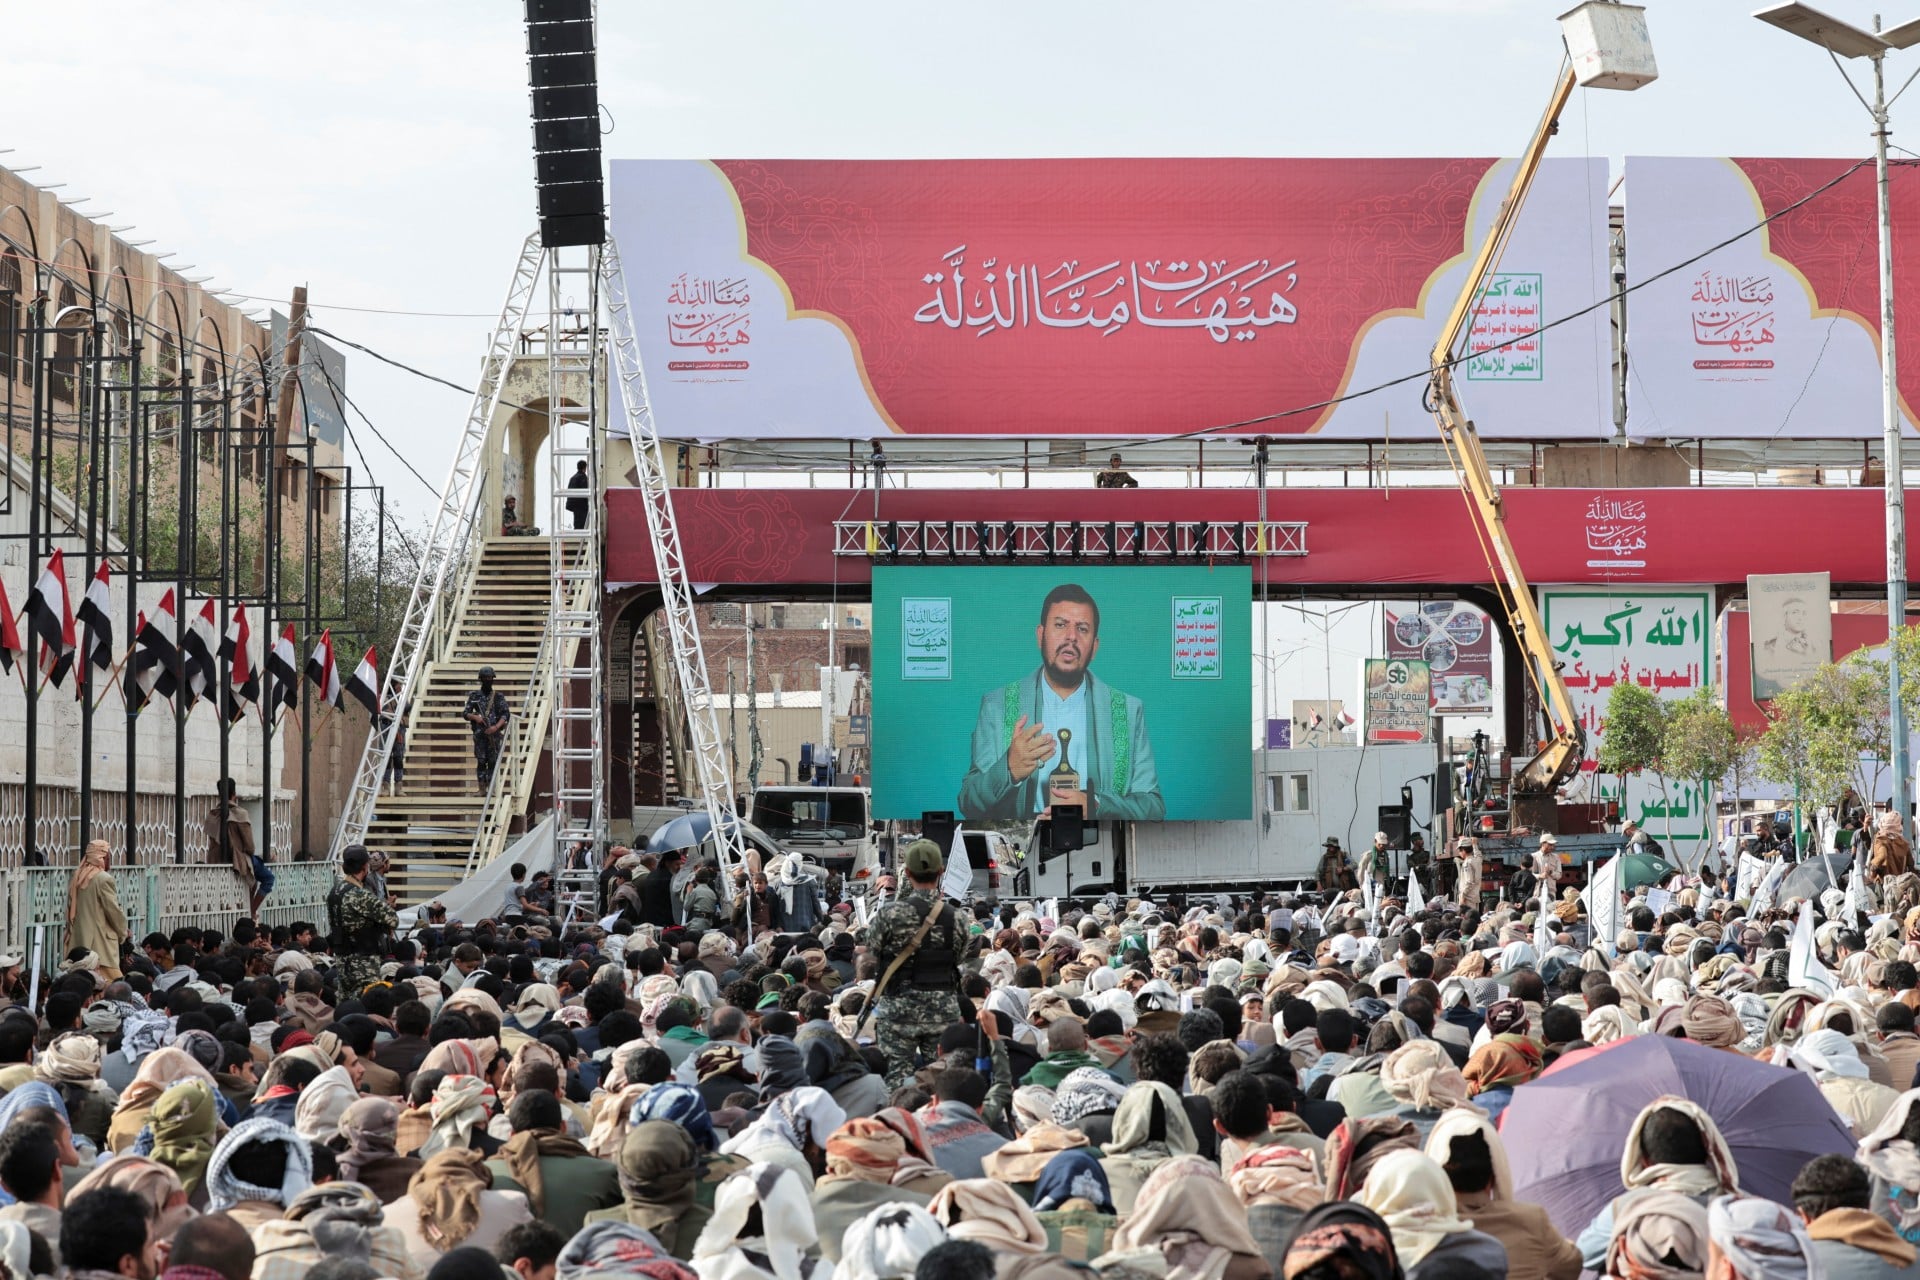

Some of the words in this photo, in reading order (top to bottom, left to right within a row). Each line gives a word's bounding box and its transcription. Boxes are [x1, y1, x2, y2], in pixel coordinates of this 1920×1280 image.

[1513, 279, 1539, 297] الله
[1508, 355, 1538, 376] النصر
[1553, 601, 1642, 658] أكبر
[1645, 606, 1700, 646] الله
[1388, 669, 1407, 684] SG
[1563, 656, 1630, 693] لأمريك
[1637, 662, 1698, 694] الموت
[1636, 782, 1698, 828] النصر
[1777, 812, 1787, 822] P
